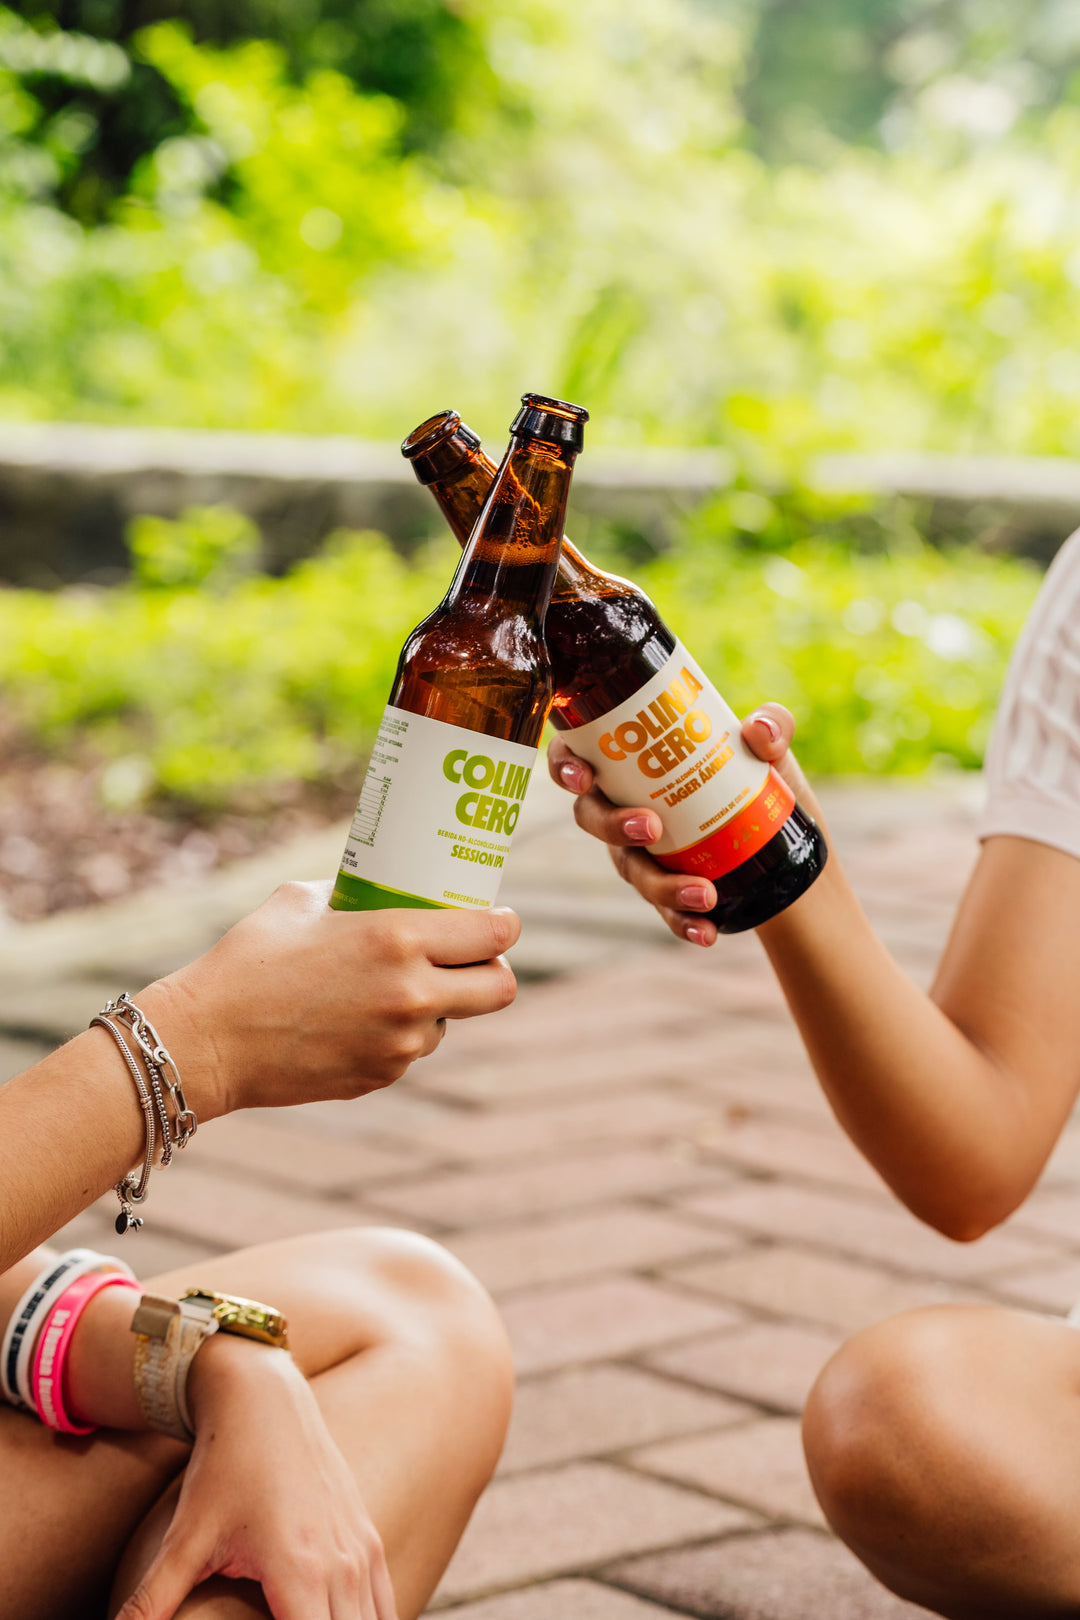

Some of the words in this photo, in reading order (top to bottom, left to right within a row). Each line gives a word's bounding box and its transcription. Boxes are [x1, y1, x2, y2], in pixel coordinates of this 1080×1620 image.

[598, 666, 704, 762] COLIMA
[637, 708, 713, 780] CERO
[663, 778, 702, 808] LAGER
[698, 745, 735, 785] ÁMBAR
[437, 829, 458, 841] BEBIDA
[455, 791, 520, 836] CERO
[450, 844, 495, 867] SESSION
